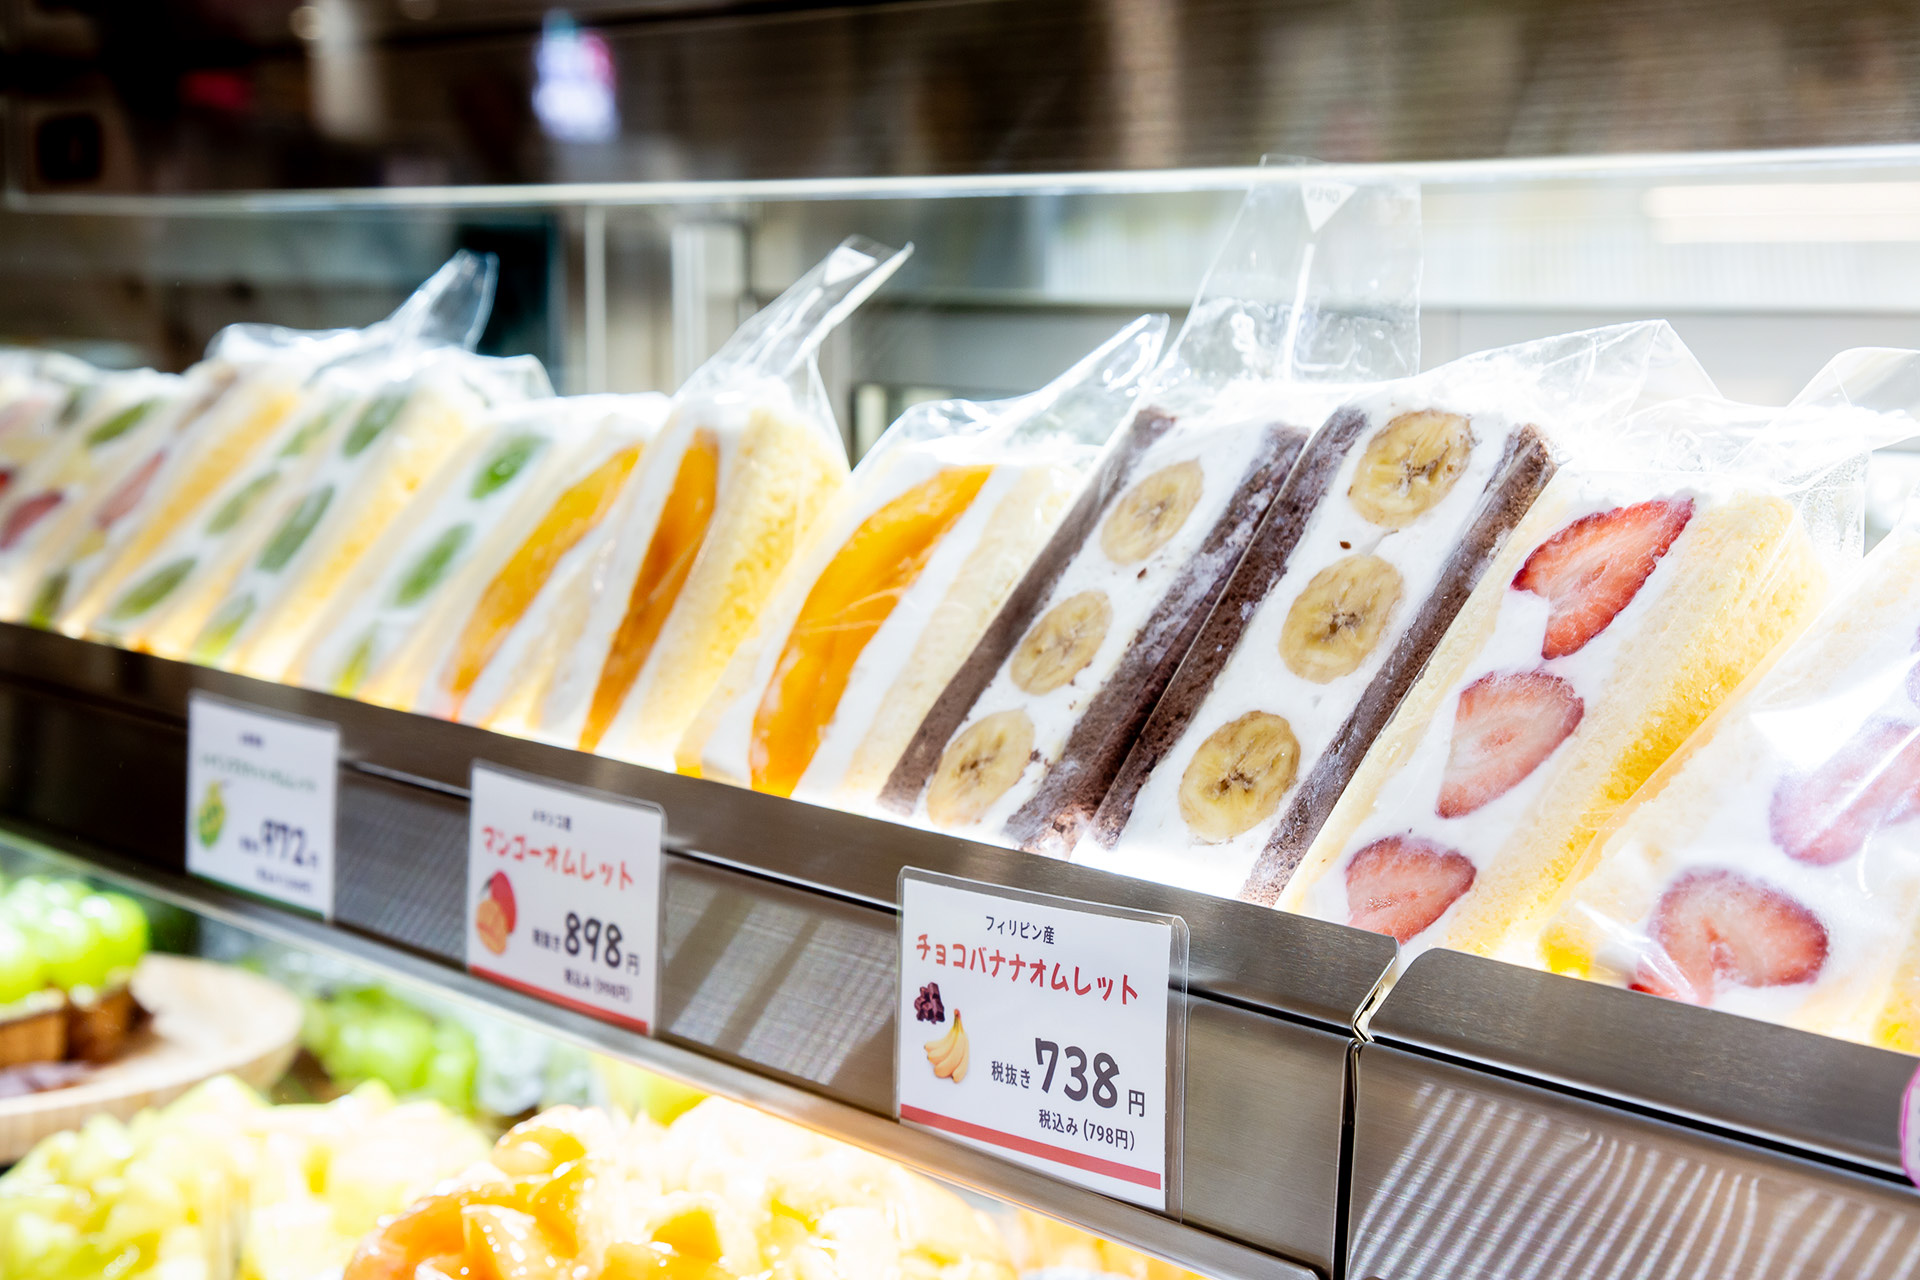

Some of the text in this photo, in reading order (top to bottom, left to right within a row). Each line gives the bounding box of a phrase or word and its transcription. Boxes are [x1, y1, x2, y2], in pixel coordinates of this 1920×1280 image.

[483, 826, 634, 890] マンゴーオムレット
[565, 912, 622, 968] 898
[986, 916, 1055, 945] フィリピン産
[916, 933, 1138, 1005] チョコバナナオムレット
[991, 1037, 1145, 1117] 税抜き 738 円
[1038, 1109, 1135, 1151] 税込み (798円)
